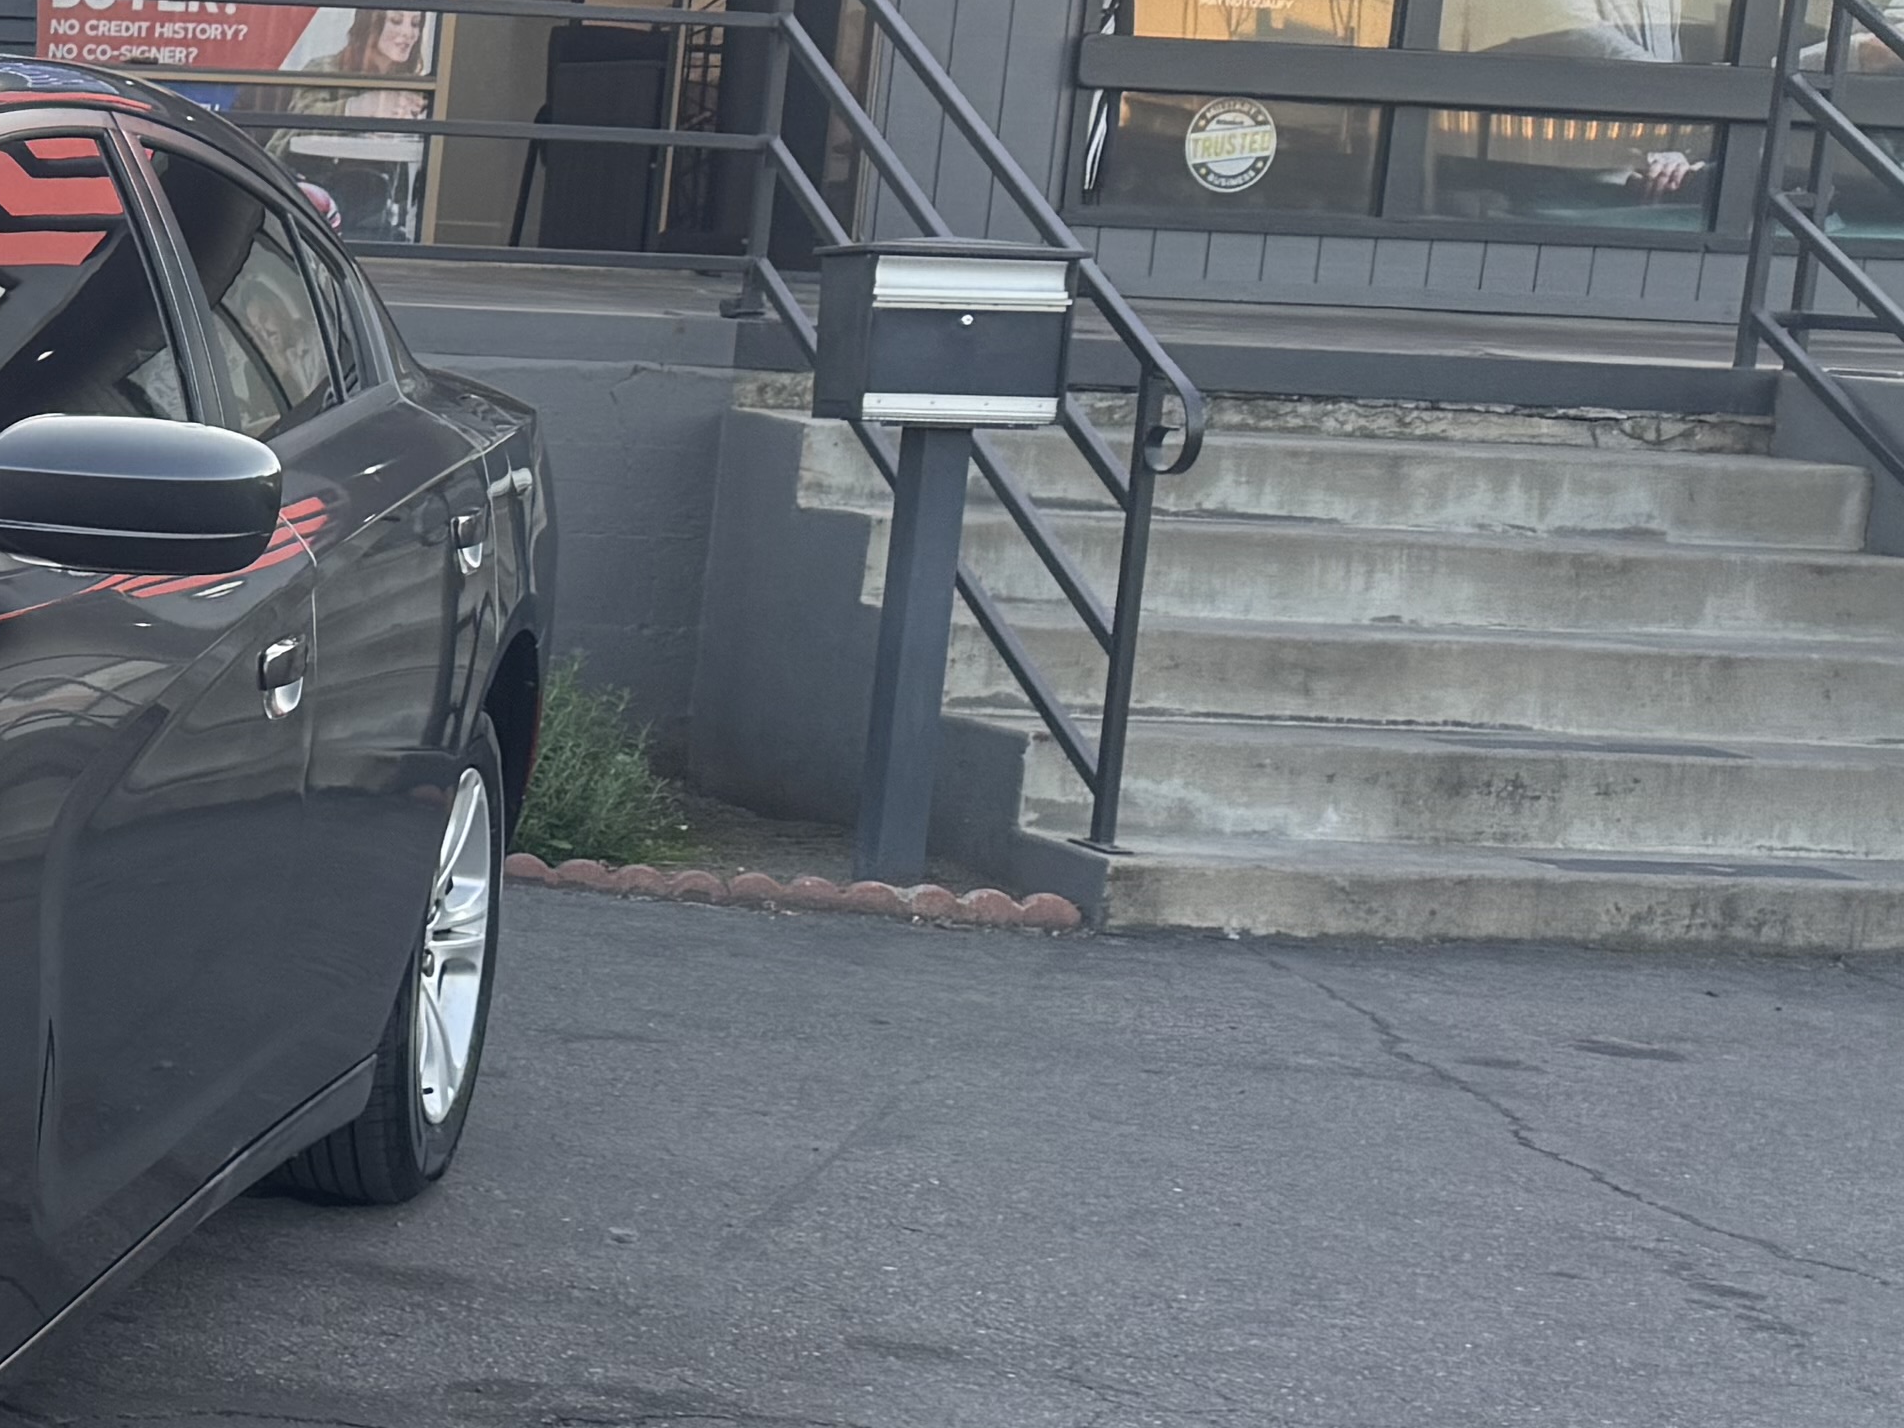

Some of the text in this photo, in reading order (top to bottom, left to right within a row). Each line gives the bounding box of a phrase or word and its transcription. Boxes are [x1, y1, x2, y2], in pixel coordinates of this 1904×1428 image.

[49, 19, 248, 41] NO CREDIT HISTORY?
[47, 43, 199, 64] NO CO-SIGNER?
[1191, 129, 1272, 159] TRUSTED
